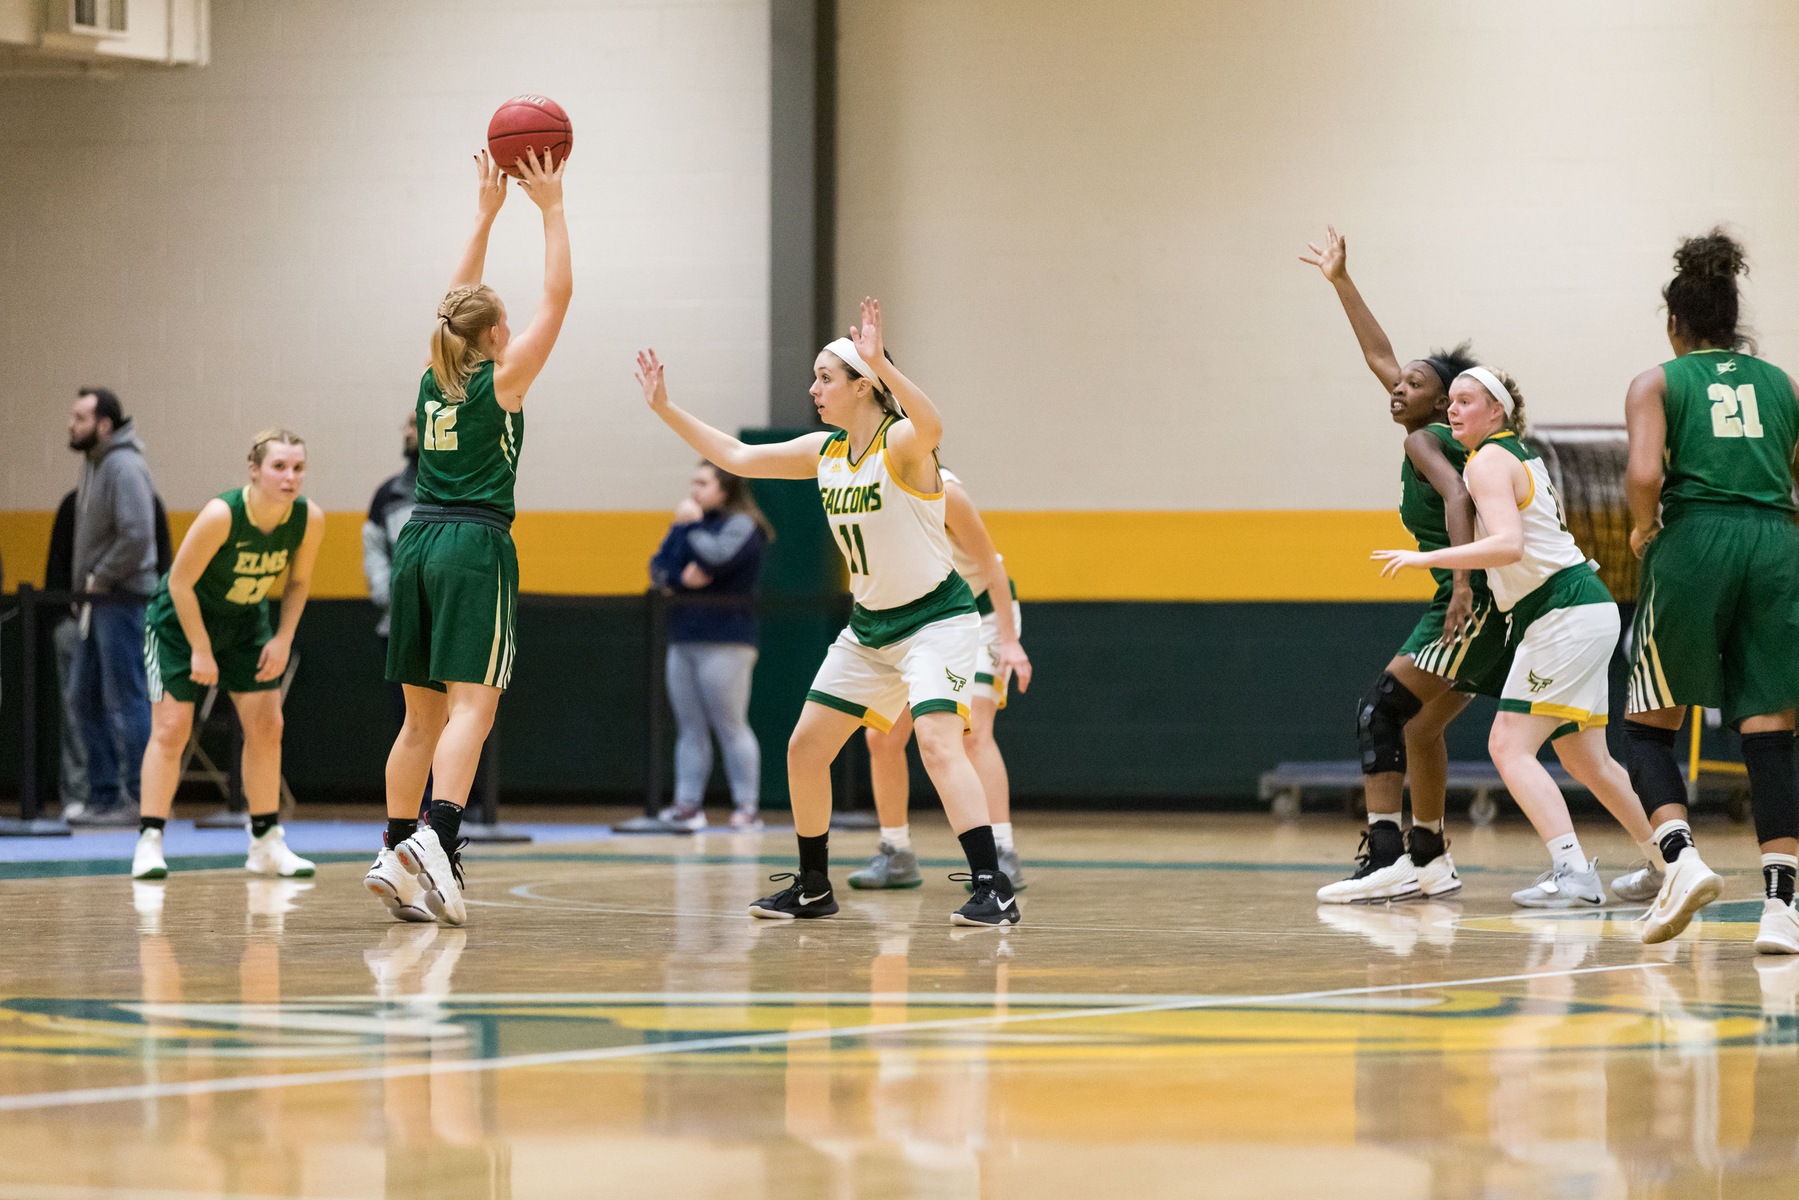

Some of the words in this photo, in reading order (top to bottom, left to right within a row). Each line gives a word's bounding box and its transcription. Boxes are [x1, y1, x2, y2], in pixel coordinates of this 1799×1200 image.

[424, 400, 459, 451] 12
[1707, 383, 1764, 438] 21
[820, 481, 882, 516] FALCONS
[233, 549, 289, 575] ELMS
[839, 523, 869, 576] 11
